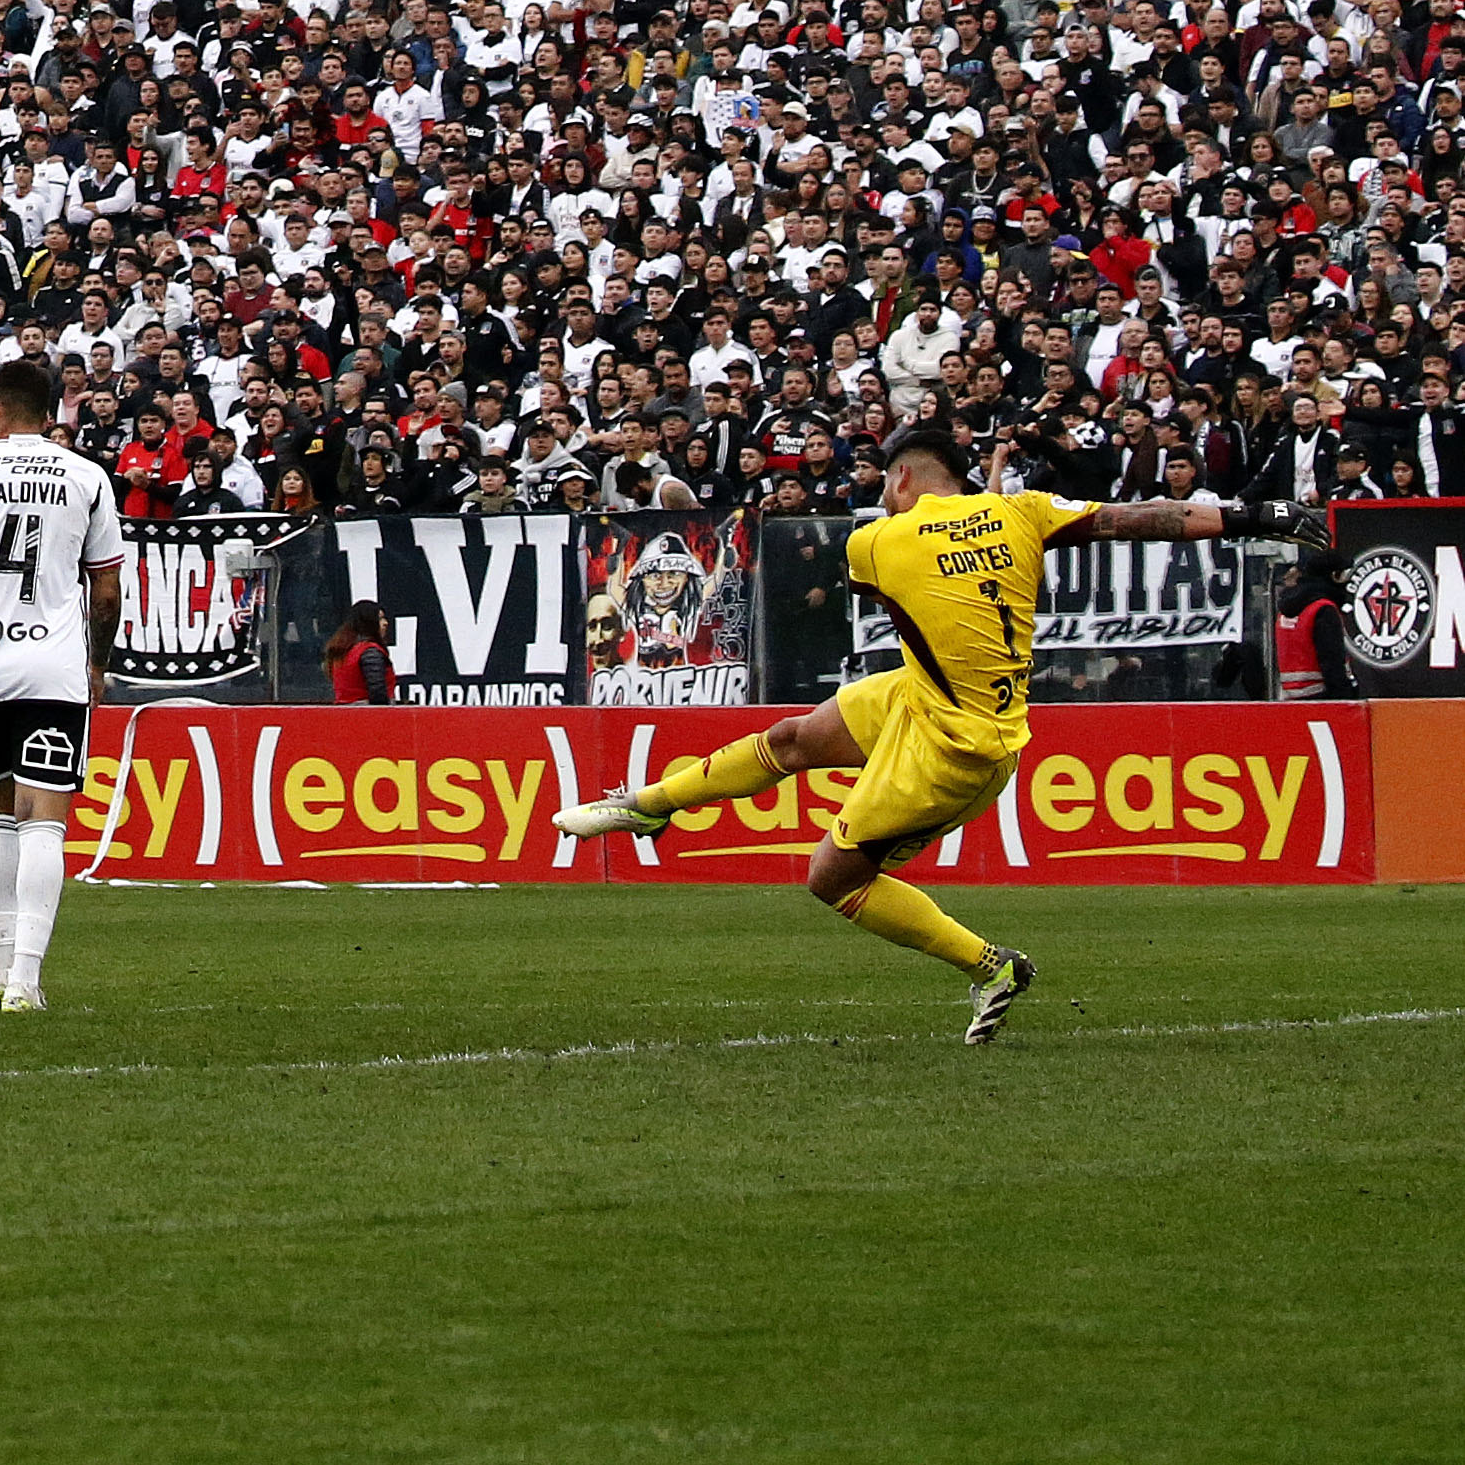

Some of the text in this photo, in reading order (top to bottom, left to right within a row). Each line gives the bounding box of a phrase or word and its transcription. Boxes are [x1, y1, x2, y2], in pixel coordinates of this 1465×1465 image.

[10, 465, 67, 478] CARD
[918, 507, 993, 536] ASSIST
[948, 519, 1003, 543] CARD
[936, 543, 1014, 578] CORTES
[338, 514, 569, 676] LVI
[978, 579, 1020, 658] 1
[592, 663, 749, 706] PORVENIR
